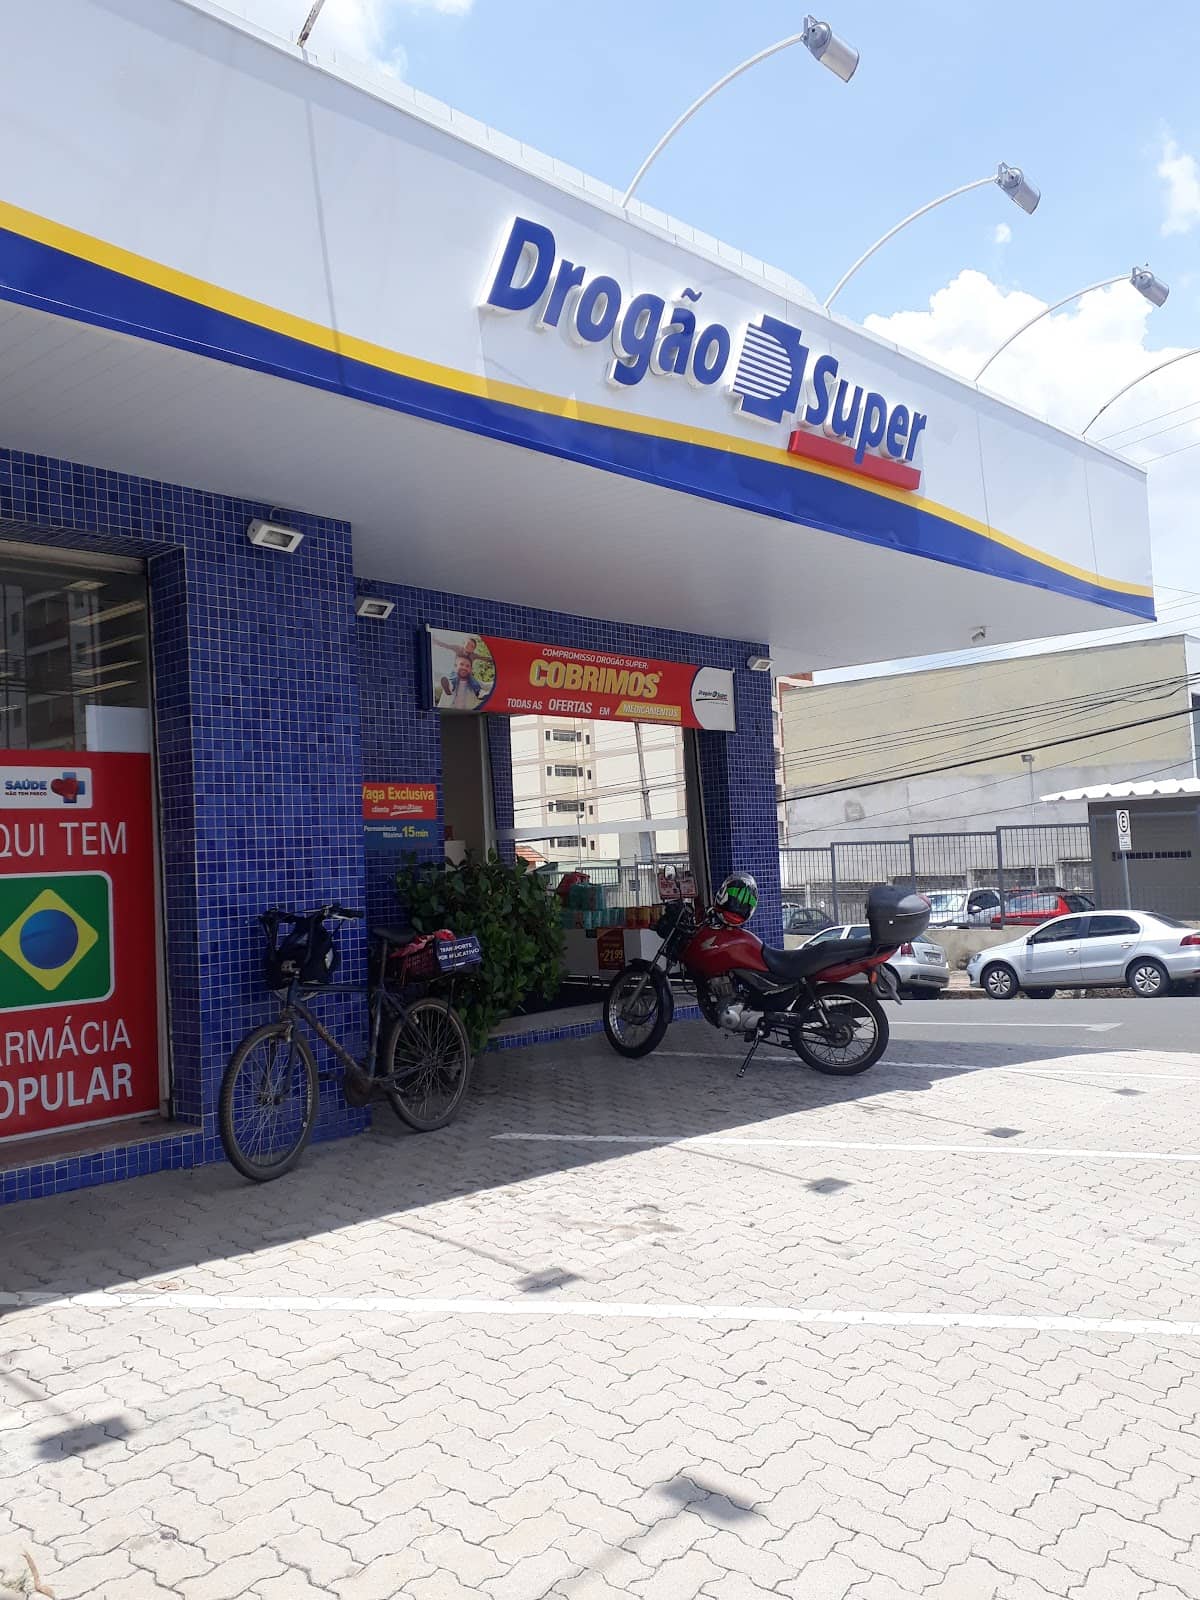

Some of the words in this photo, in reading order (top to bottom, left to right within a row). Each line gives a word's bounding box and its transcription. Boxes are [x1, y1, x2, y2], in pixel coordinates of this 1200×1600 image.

[483, 216, 731, 387] Drogão
[804, 354, 927, 465] Super
[542, 648, 596, 664] COMPROMISSO
[596, 655, 625, 667] DROGÃO
[507, 698, 532, 710] TODAS
[532, 700, 543, 710] AS
[548, 698, 593, 714] OFERTAS
[600, 707, 610, 716] EM
[622, 702, 679, 719] MEDICAMENTOS
[5, 779, 48, 790] SAÚDE
[388, 786, 434, 801] Exclusiva
[59, 821, 127, 856] TEM
[401, 825, 416, 838] 15
[440, 943, 473, 953] TRANPORTE
[0, 1015, 131, 1067] RMÁCIA
